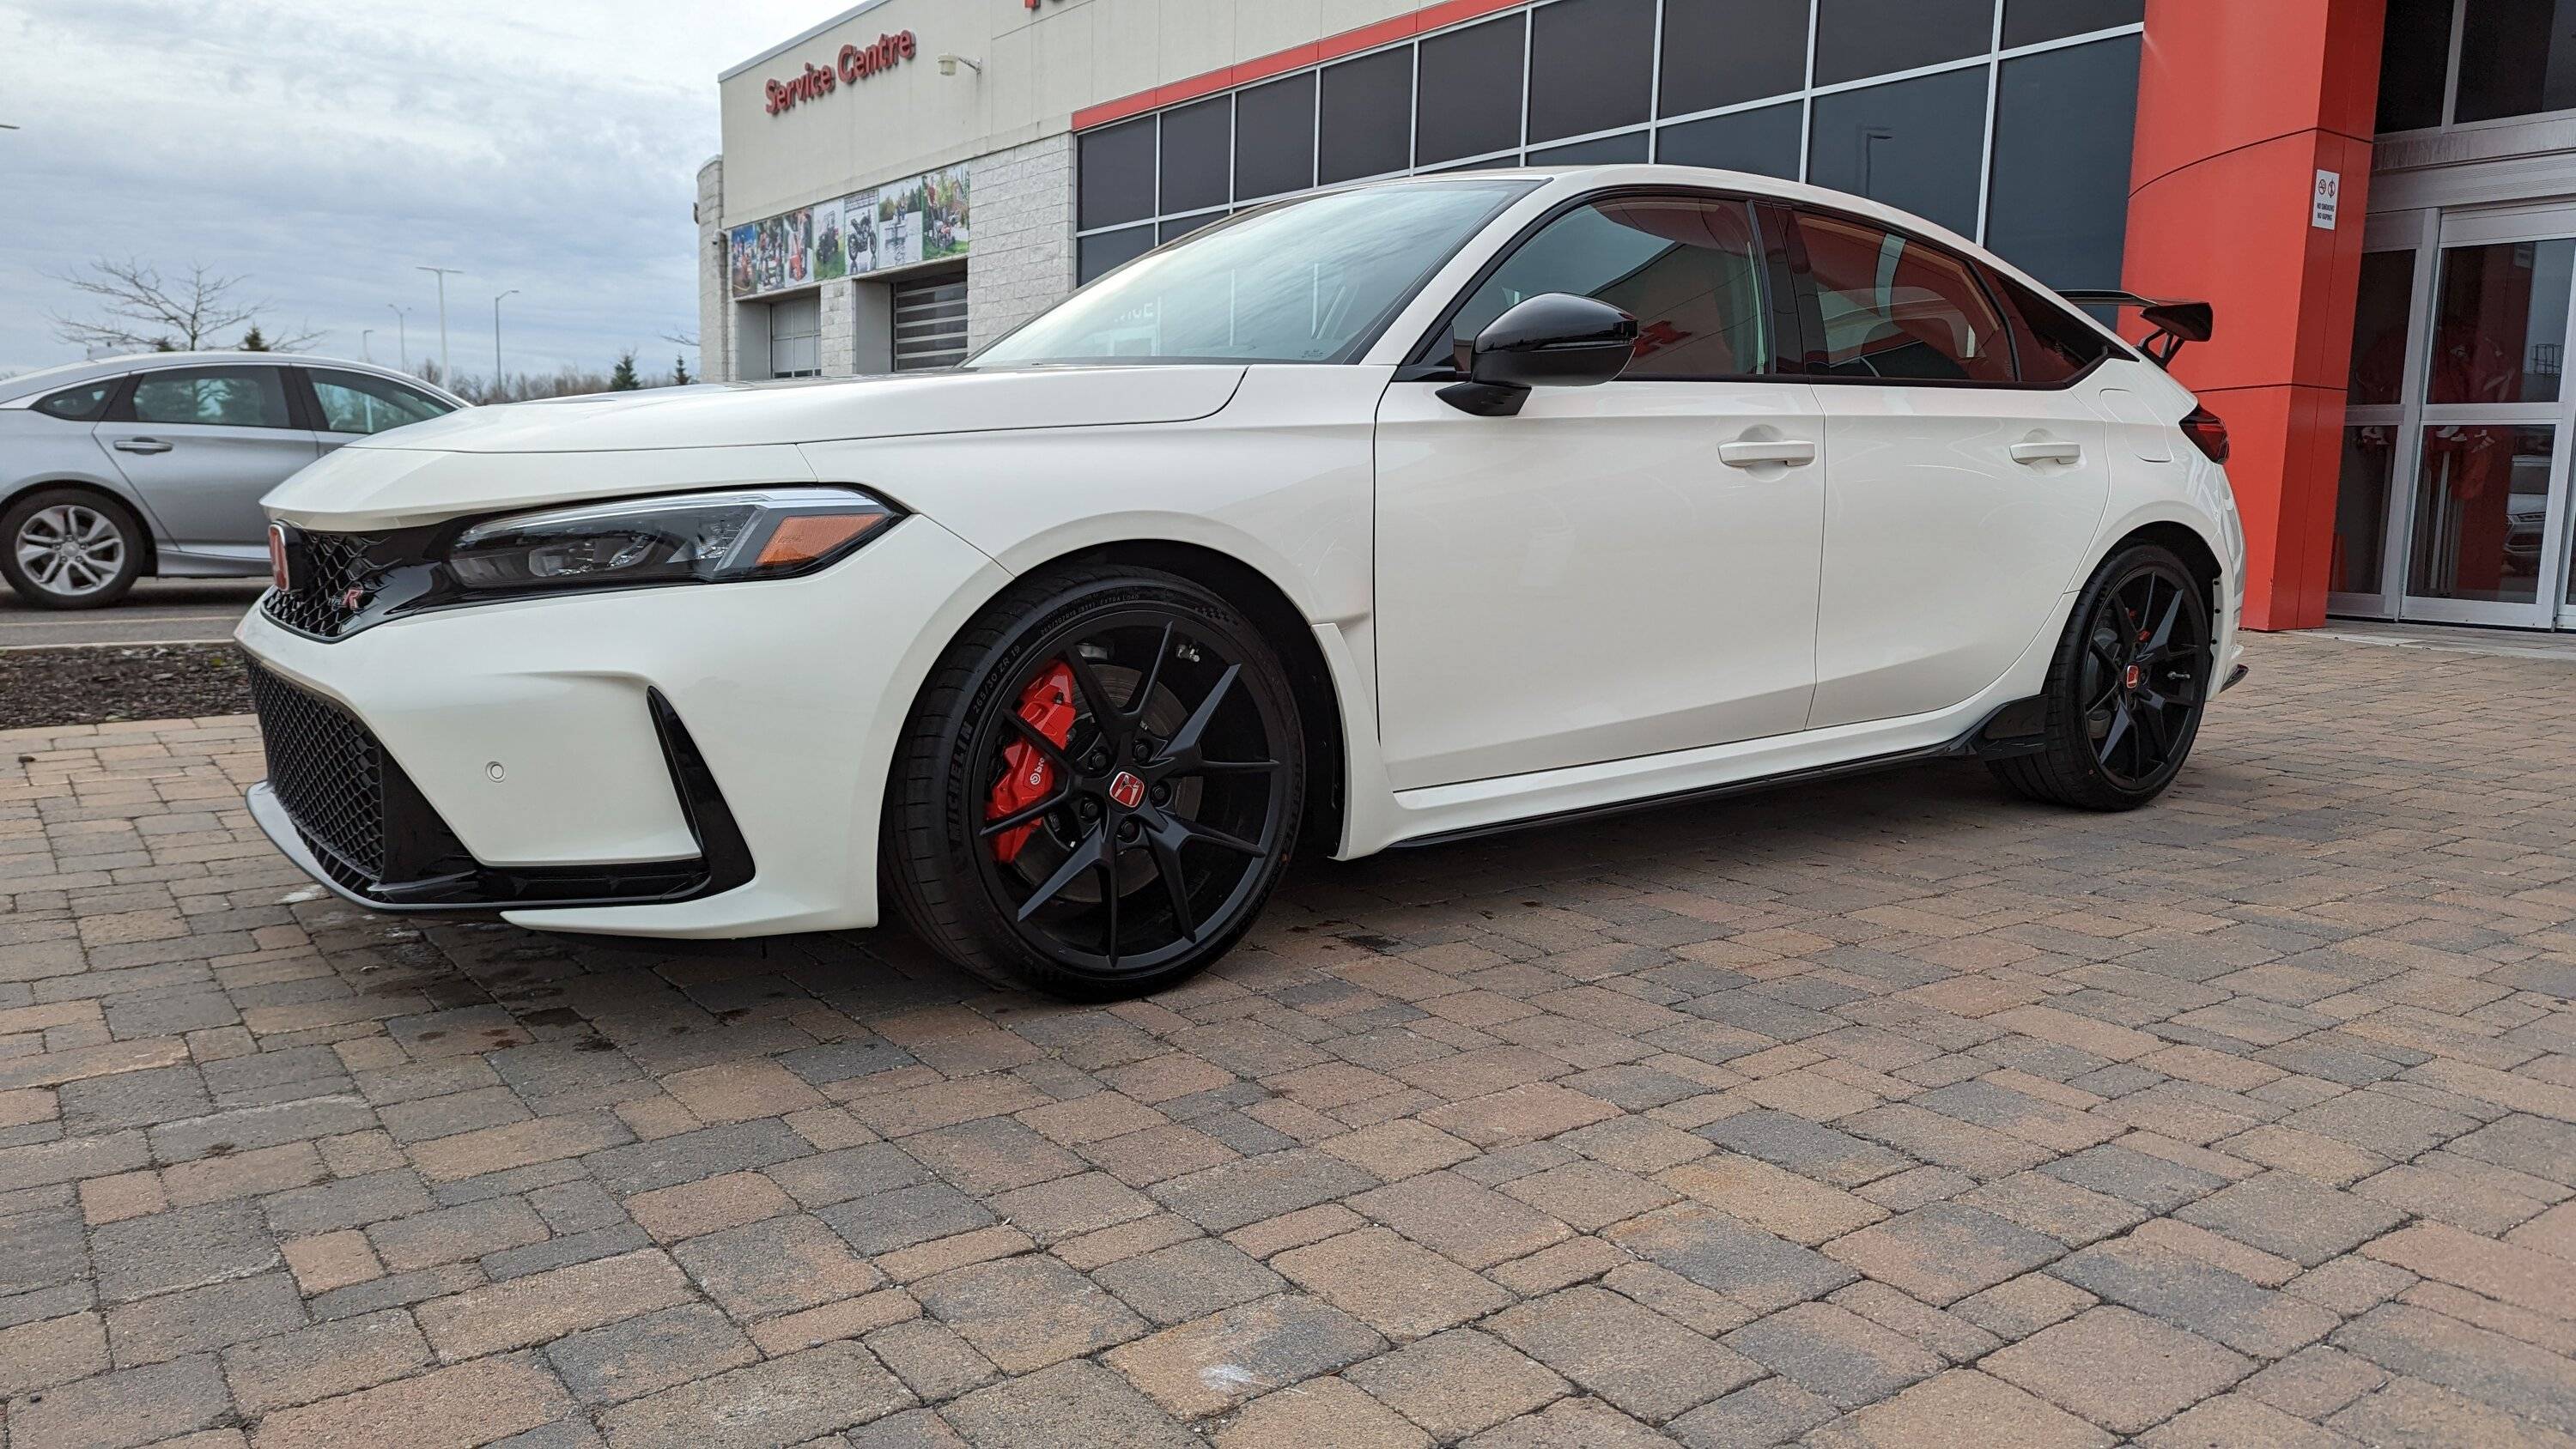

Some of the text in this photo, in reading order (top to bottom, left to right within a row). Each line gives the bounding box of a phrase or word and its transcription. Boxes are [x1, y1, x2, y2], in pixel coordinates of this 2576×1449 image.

[765, 29, 914, 114] Service Centre
[342, 586, 364, 610] R
[946, 645, 1022, 846] MICHELIN 265/30 ZR 19
[1034, 757, 1045, 773] bre
